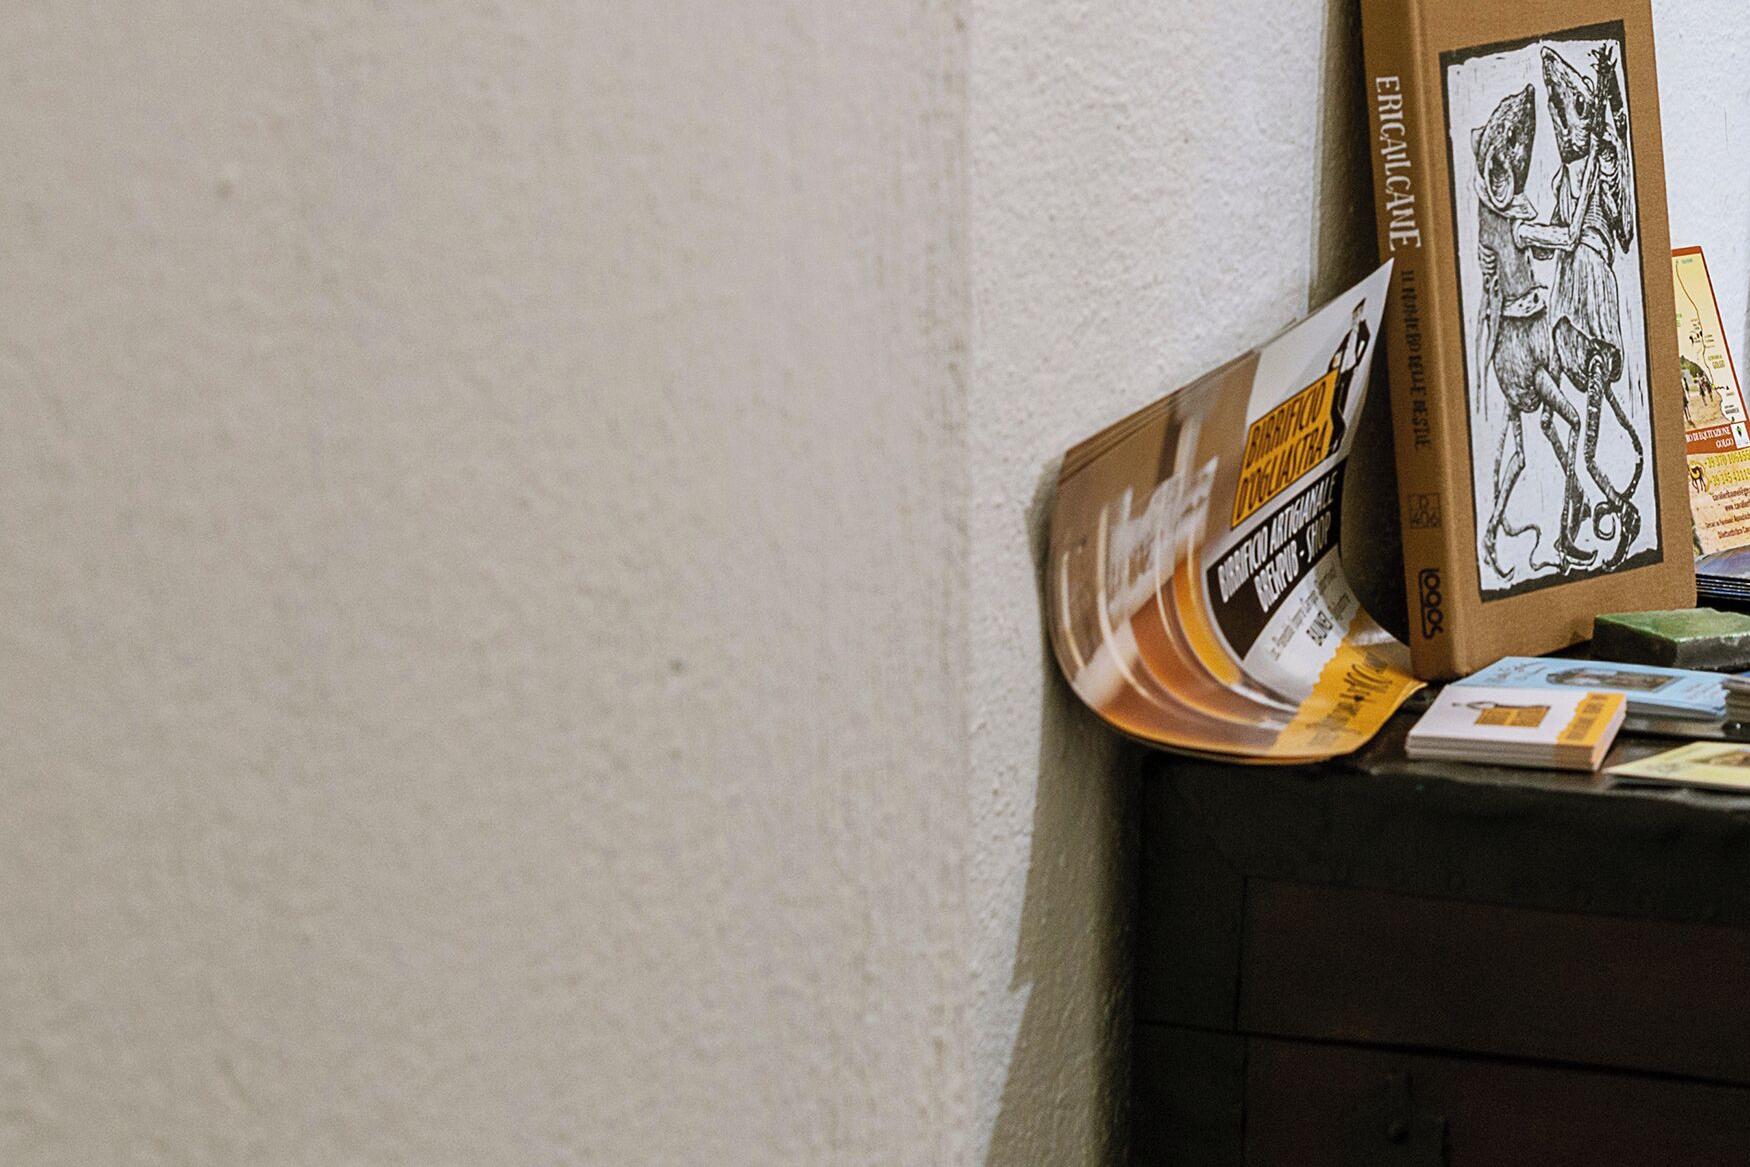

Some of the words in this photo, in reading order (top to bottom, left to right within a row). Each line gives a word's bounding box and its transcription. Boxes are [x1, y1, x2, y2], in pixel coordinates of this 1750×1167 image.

[1375, 75, 1422, 252] ERICAILCANE
[1408, 355, 1427, 397] DELLE
[1245, 380, 1327, 469] BIRRIFICIO
